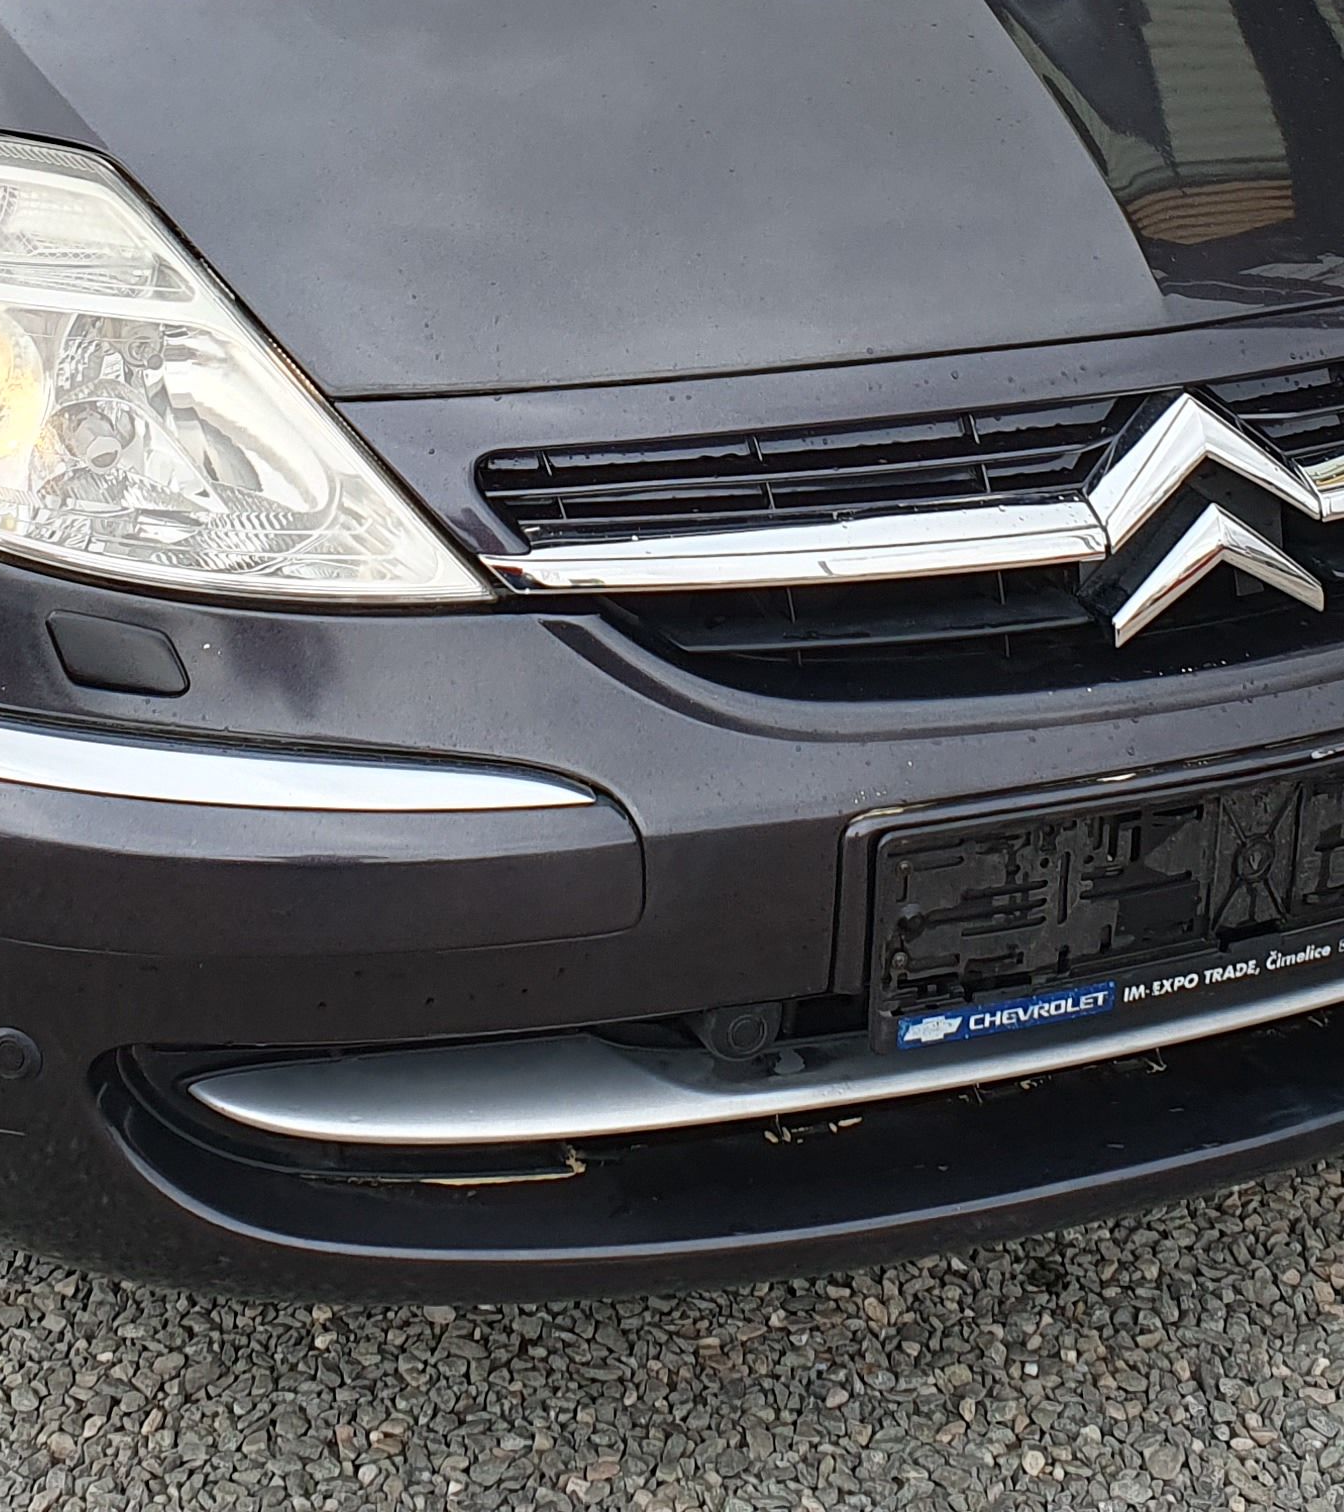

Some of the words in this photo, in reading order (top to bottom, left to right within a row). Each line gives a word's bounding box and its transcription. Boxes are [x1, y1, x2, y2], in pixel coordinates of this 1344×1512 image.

[1123, 974, 1199, 1002] IM-EXPO
[1203, 962, 1260, 985] TRADE,
[1265, 945, 1331, 971] Čimelice
[969, 992, 1108, 1030] CHEVROLET
